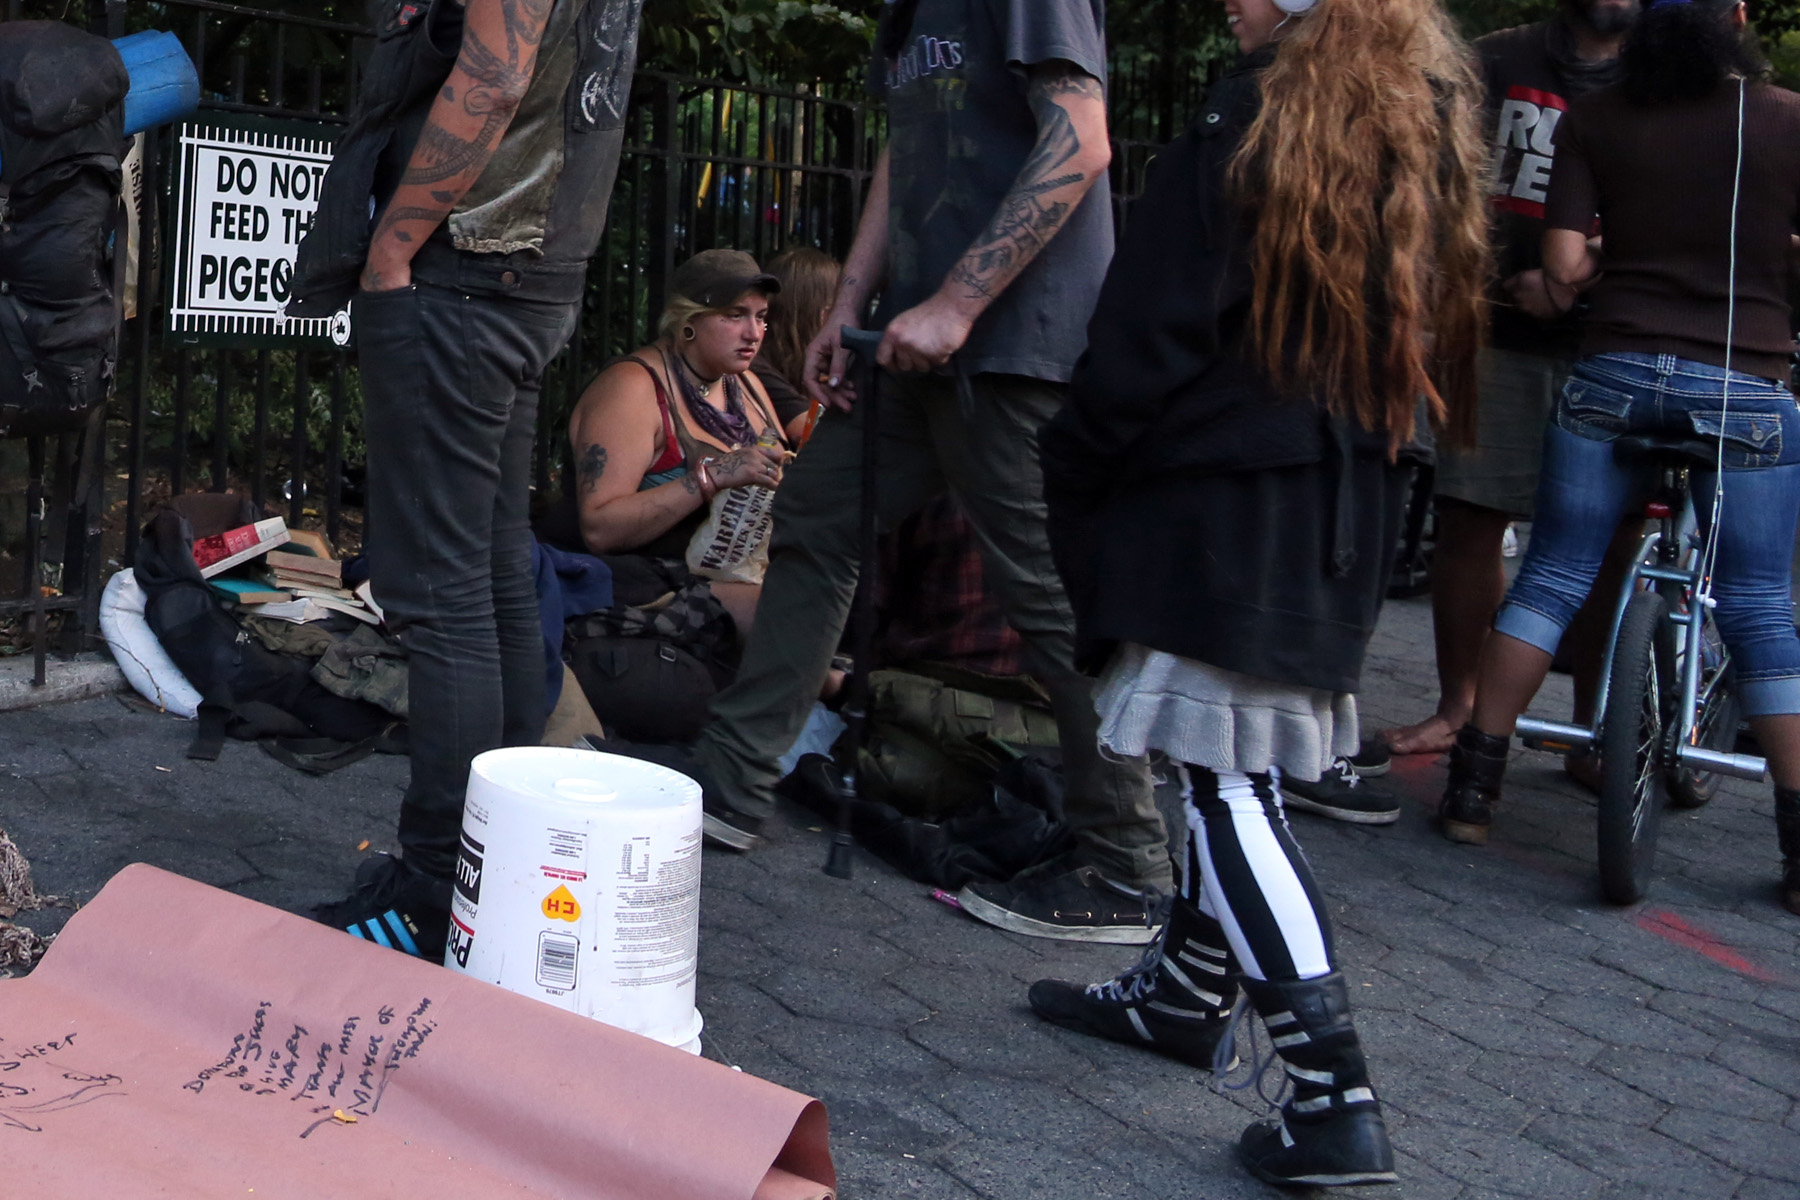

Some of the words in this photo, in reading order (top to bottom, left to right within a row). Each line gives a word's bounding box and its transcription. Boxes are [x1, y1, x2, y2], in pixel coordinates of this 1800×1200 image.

[216, 155, 258, 195] DO
[269, 161, 325, 202] NOT
[210, 200, 270, 242] FEED
[281, 207, 314, 246] TH
[198, 253, 297, 304] PIGEO
[700, 486, 751, 570] WAREHO
